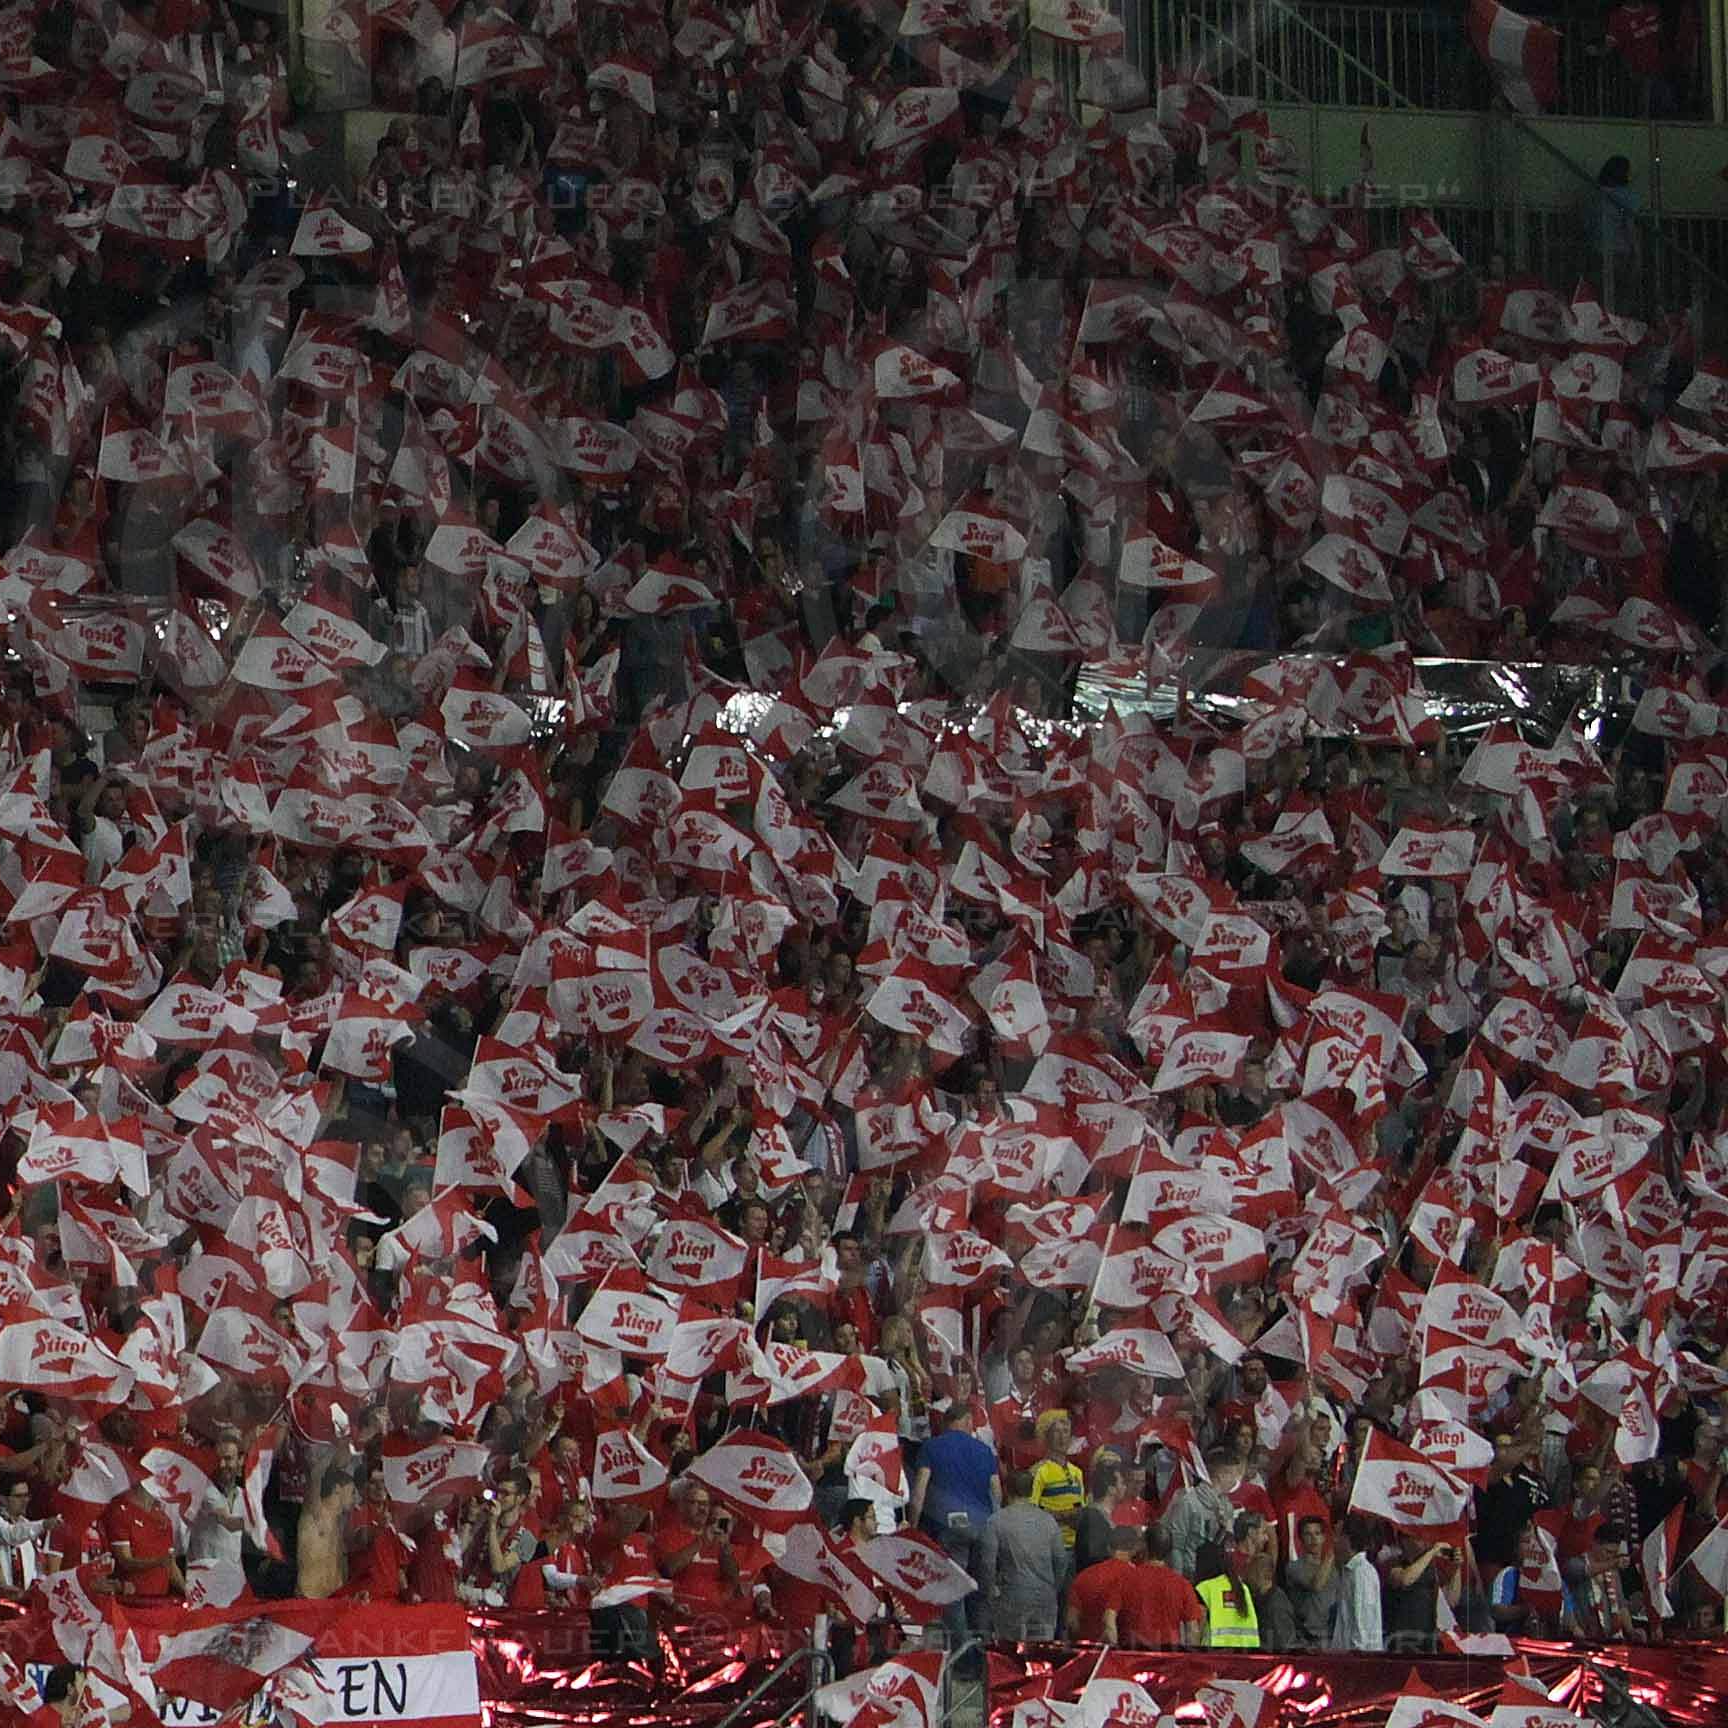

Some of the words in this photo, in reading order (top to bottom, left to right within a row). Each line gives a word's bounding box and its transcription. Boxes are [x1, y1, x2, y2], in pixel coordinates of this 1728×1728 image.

[170, 992, 228, 1019] Stiegl
[1181, 1041, 1229, 1069] Stiegl
[664, 1228, 717, 1262] Stiegl
[1181, 1225, 1233, 1253] Stiegl
[609, 1303, 665, 1337] Stiegl
[1450, 1295, 1504, 1322] Stiegl
[31, 1327, 90, 1356] Stiegl
[738, 1456, 795, 1489] Stiegl
